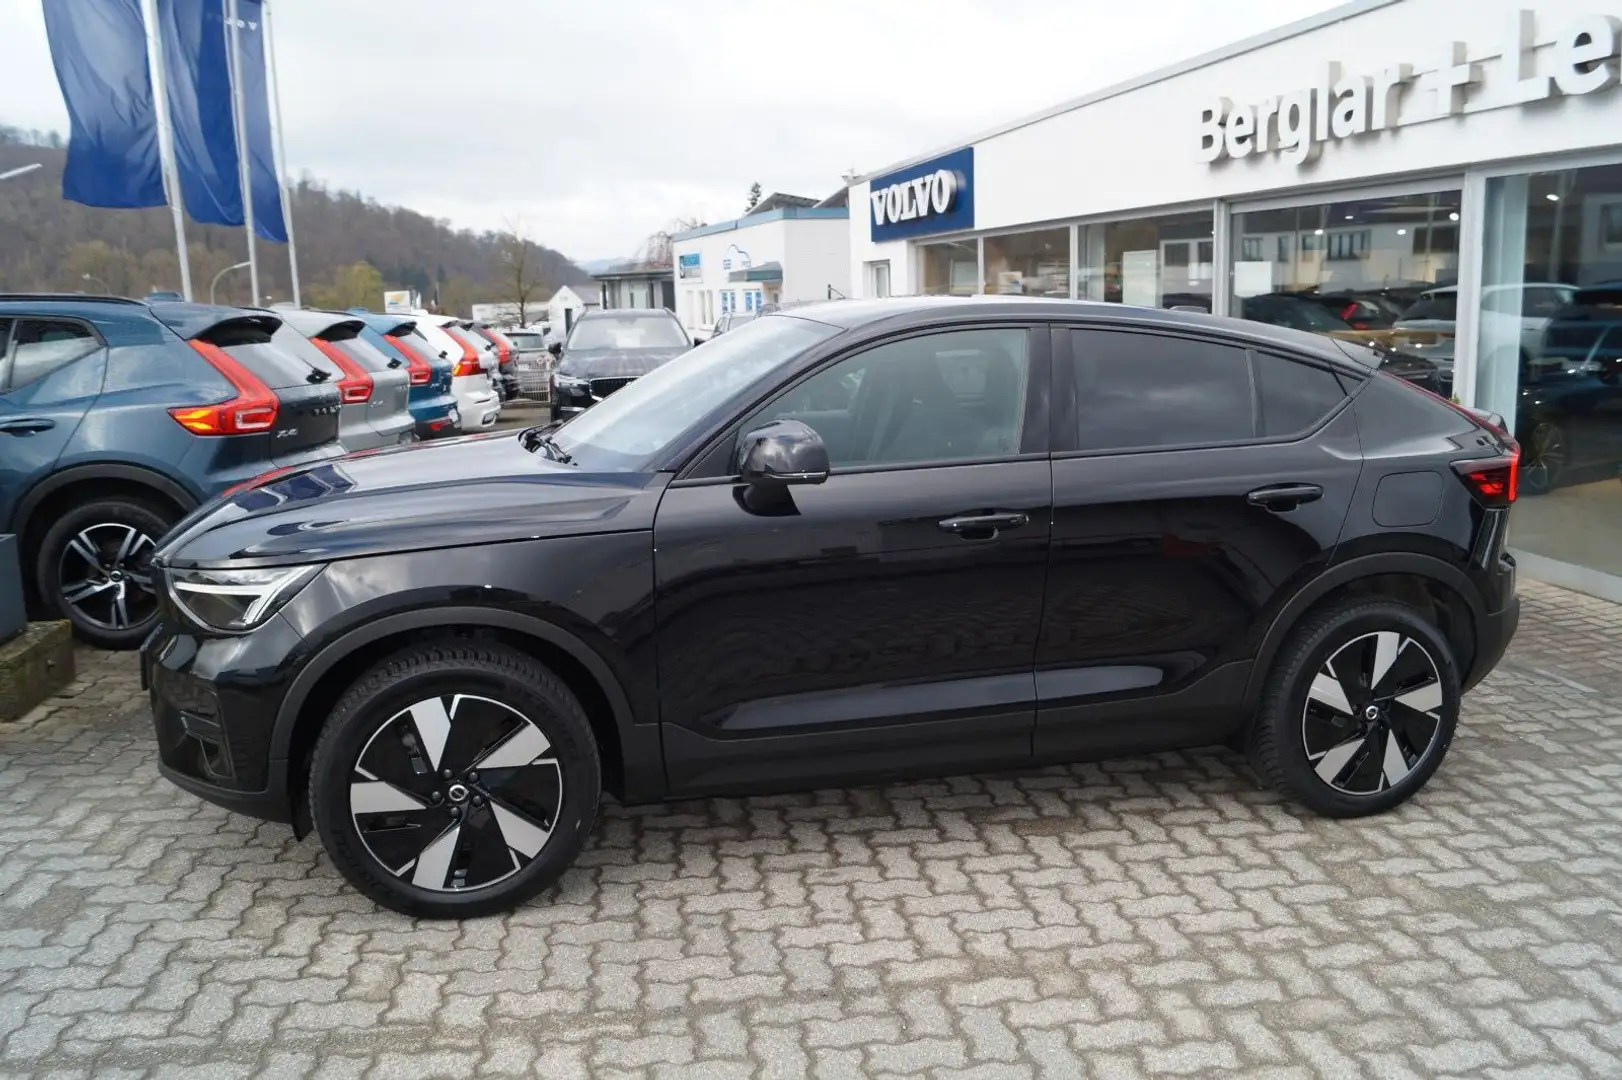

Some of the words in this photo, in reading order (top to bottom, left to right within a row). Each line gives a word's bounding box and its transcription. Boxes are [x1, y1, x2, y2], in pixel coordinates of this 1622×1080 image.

[1197, 61, 1411, 165] Berglar
[1501, 9, 1622, 104] Le
[871, 169, 955, 225] VOLVO
